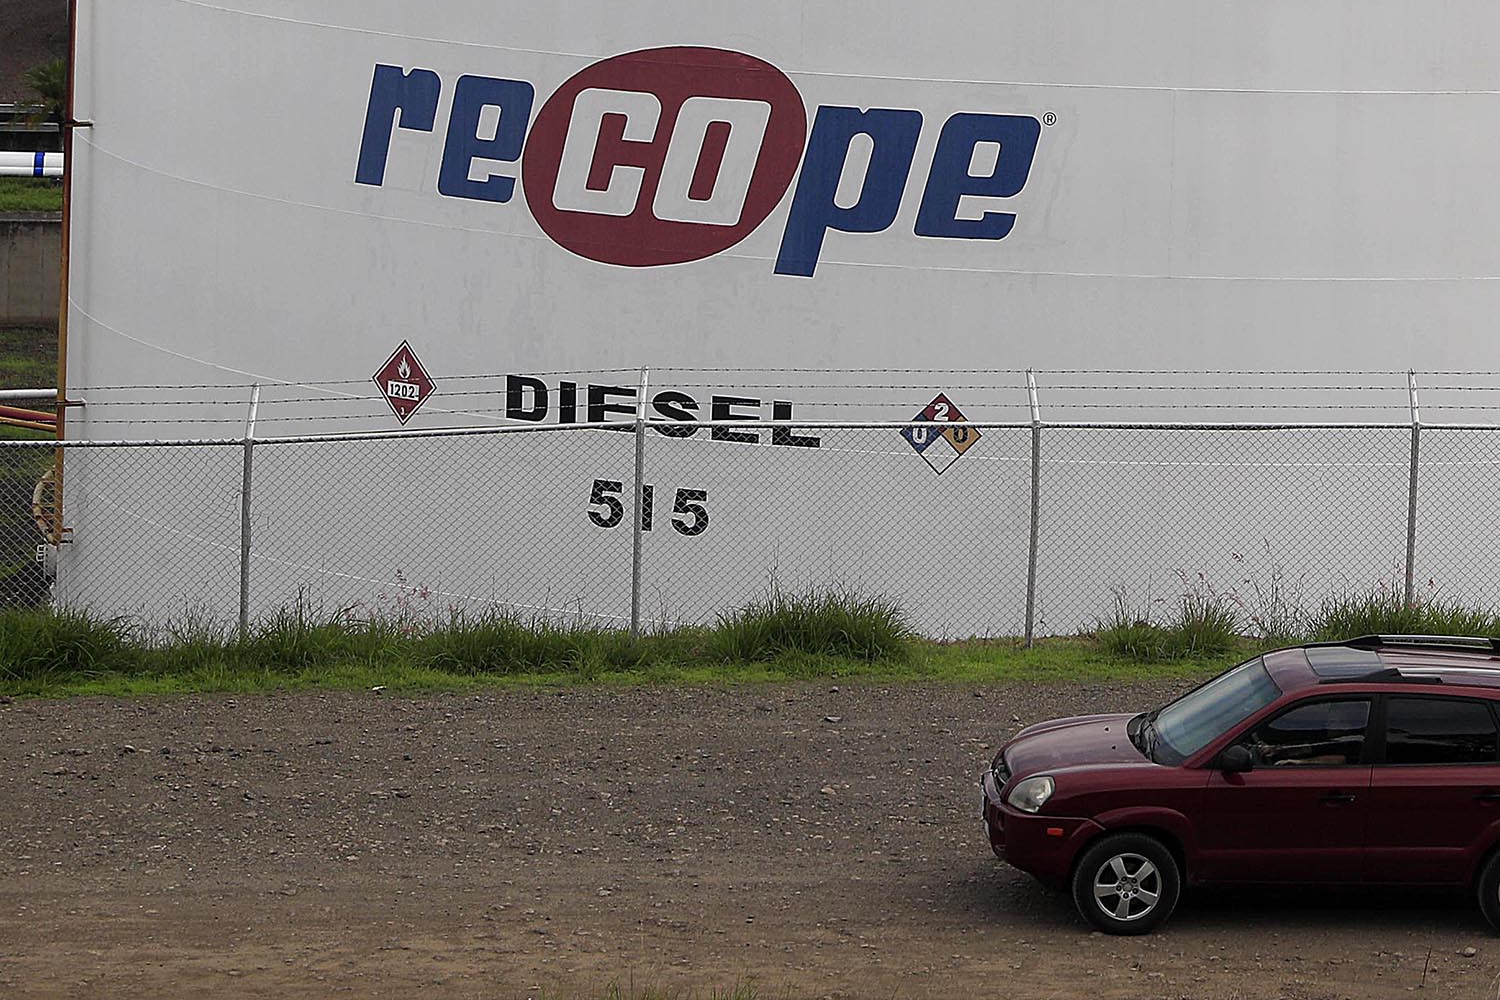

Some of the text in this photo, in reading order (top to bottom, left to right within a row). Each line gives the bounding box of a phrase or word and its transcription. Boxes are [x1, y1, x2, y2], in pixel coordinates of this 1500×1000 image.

[390, 383, 415, 398] 1202
[505, 374, 822, 449] DIESEL
[933, 402, 949, 421] 2
[587, 478, 710, 537] 515
